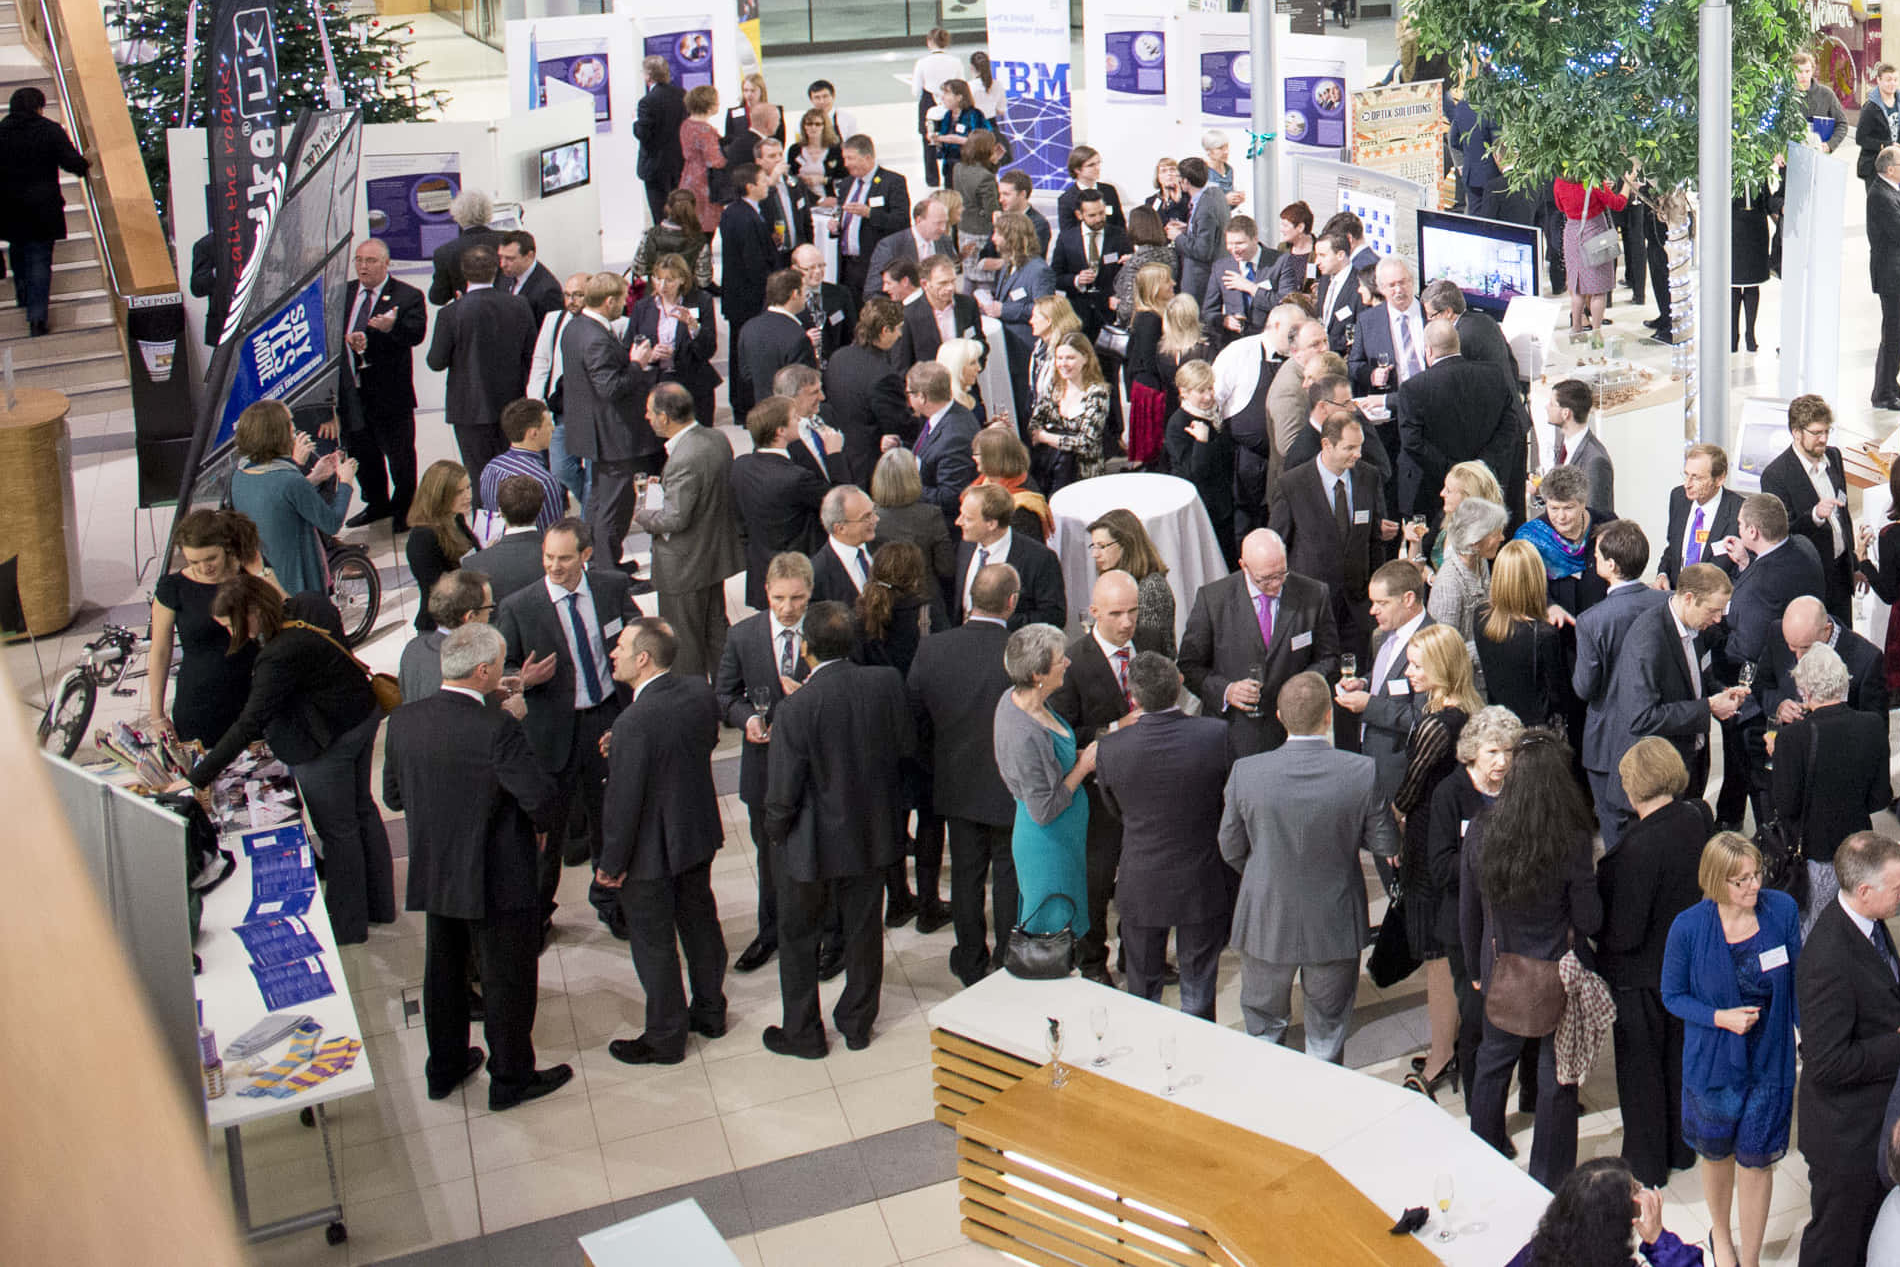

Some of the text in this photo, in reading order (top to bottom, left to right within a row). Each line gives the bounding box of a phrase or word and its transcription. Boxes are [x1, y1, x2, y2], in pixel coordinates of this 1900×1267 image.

[1394, 103, 1433, 119] SOLUTIONS
[268, 312, 296, 374] YES
[290, 303, 313, 357] SAY
[252, 330, 277, 387] MORE
